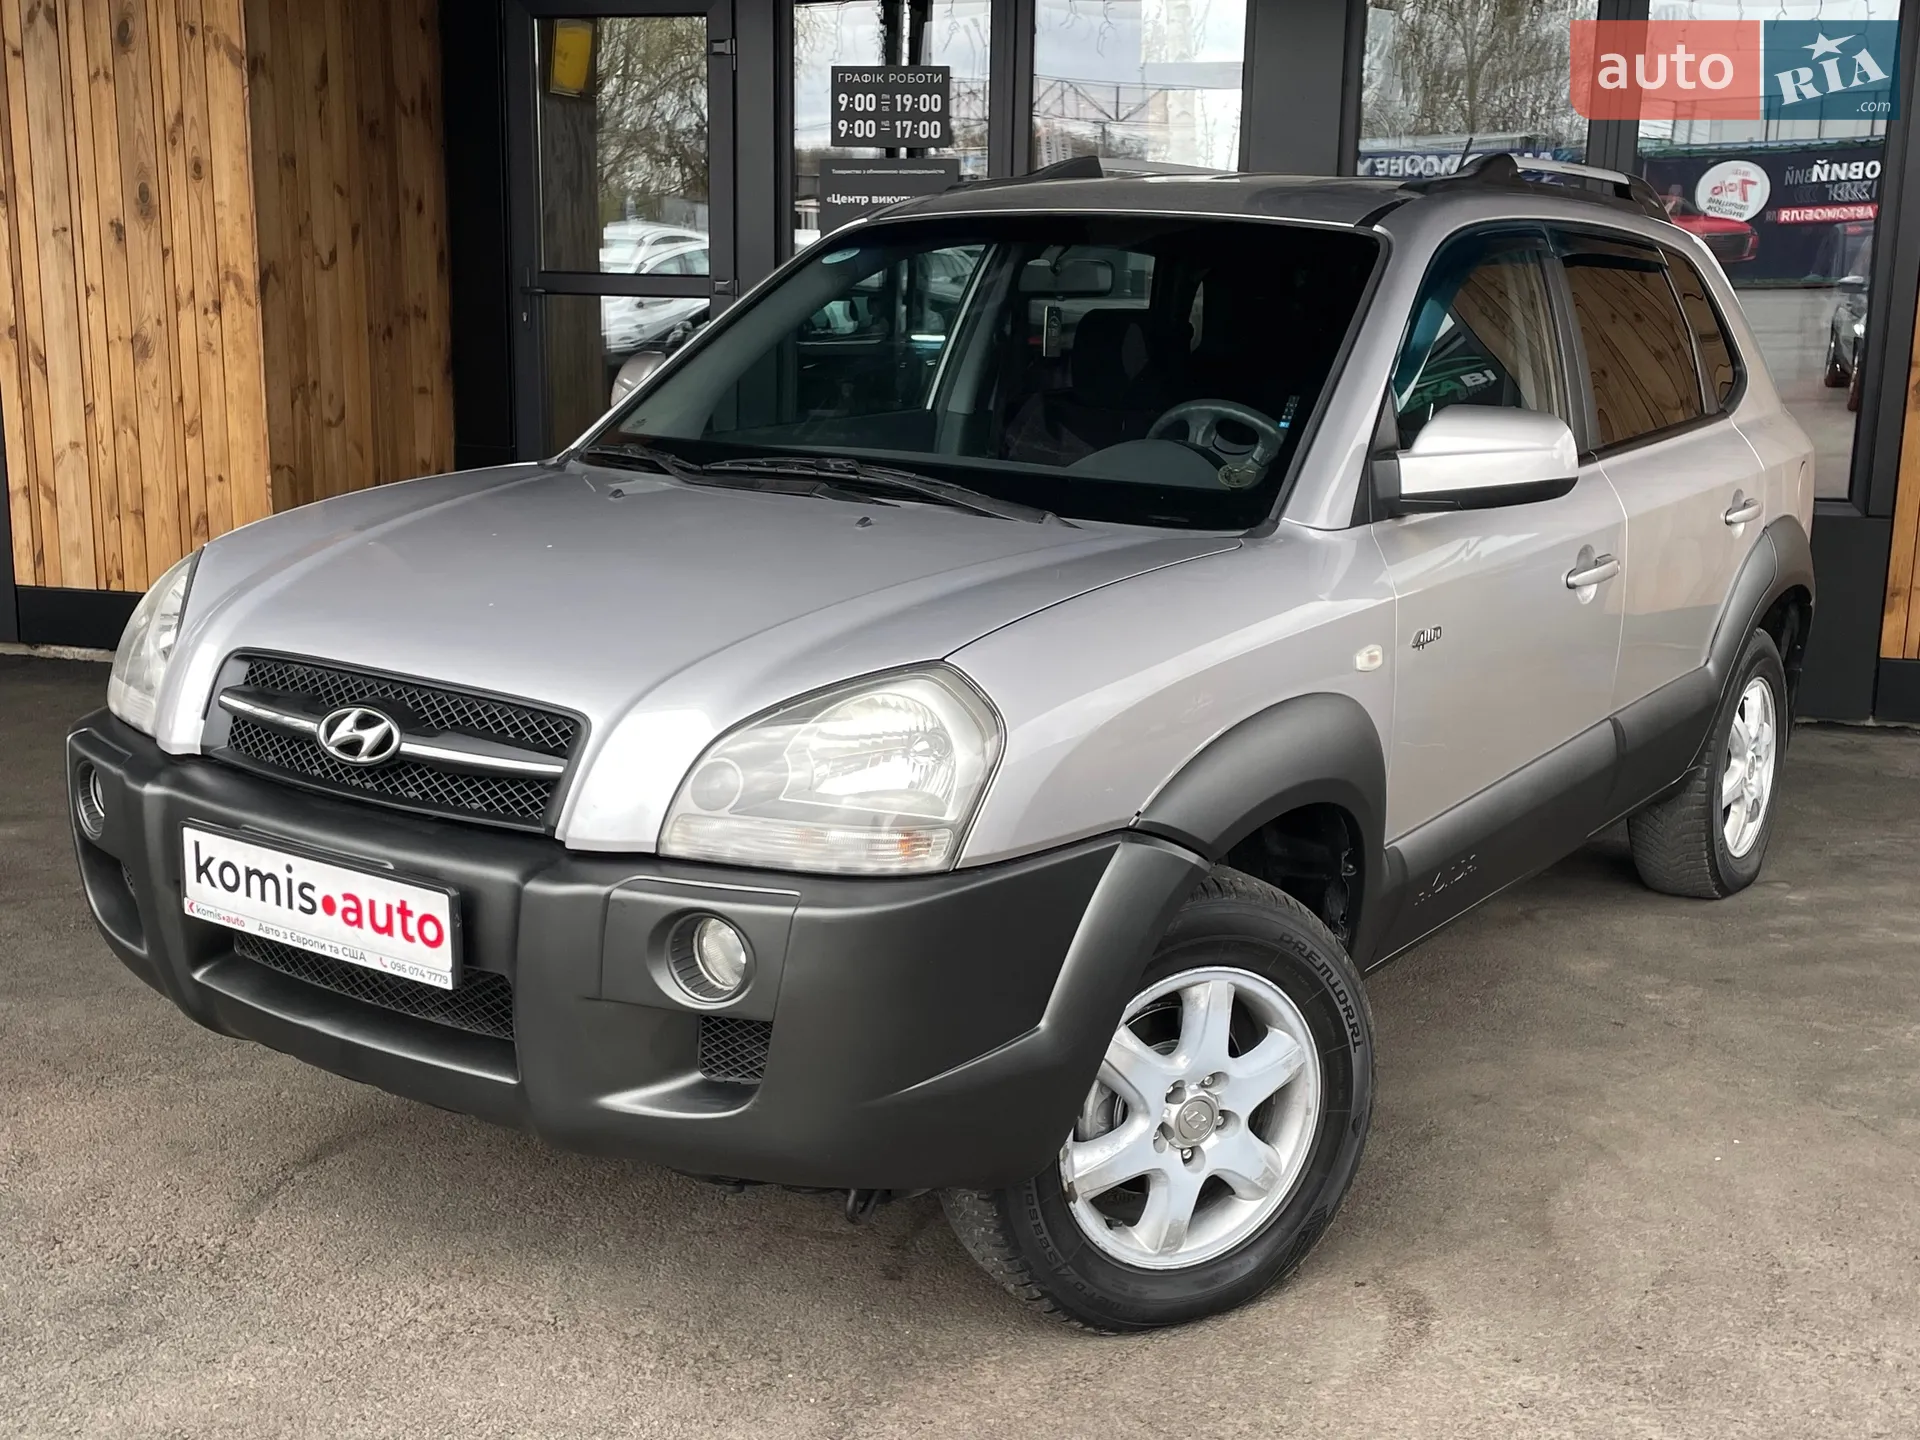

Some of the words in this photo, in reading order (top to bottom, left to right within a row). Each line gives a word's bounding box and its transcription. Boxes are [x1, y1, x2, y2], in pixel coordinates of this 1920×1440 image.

[838, 73, 884, 83] ГРАФІК
[889, 73, 943, 84] РОБОТИ
[838, 93, 876, 112] 9:00
[895, 94, 942, 112] 19:00
[838, 120, 876, 138] 9:00
[895, 120, 941, 139] 17:00
[826, 194, 869, 206] «Центр
[257, 922, 281, 938] Авто
[282, 930, 288, 940] з
[290, 932, 326, 952] Європи
[328, 943, 339, 955] та
[342, 946, 367, 963] США
[390, 961, 410, 973] 096
[409, 965, 426, 979] 074
[426, 970, 449, 985] 7779
